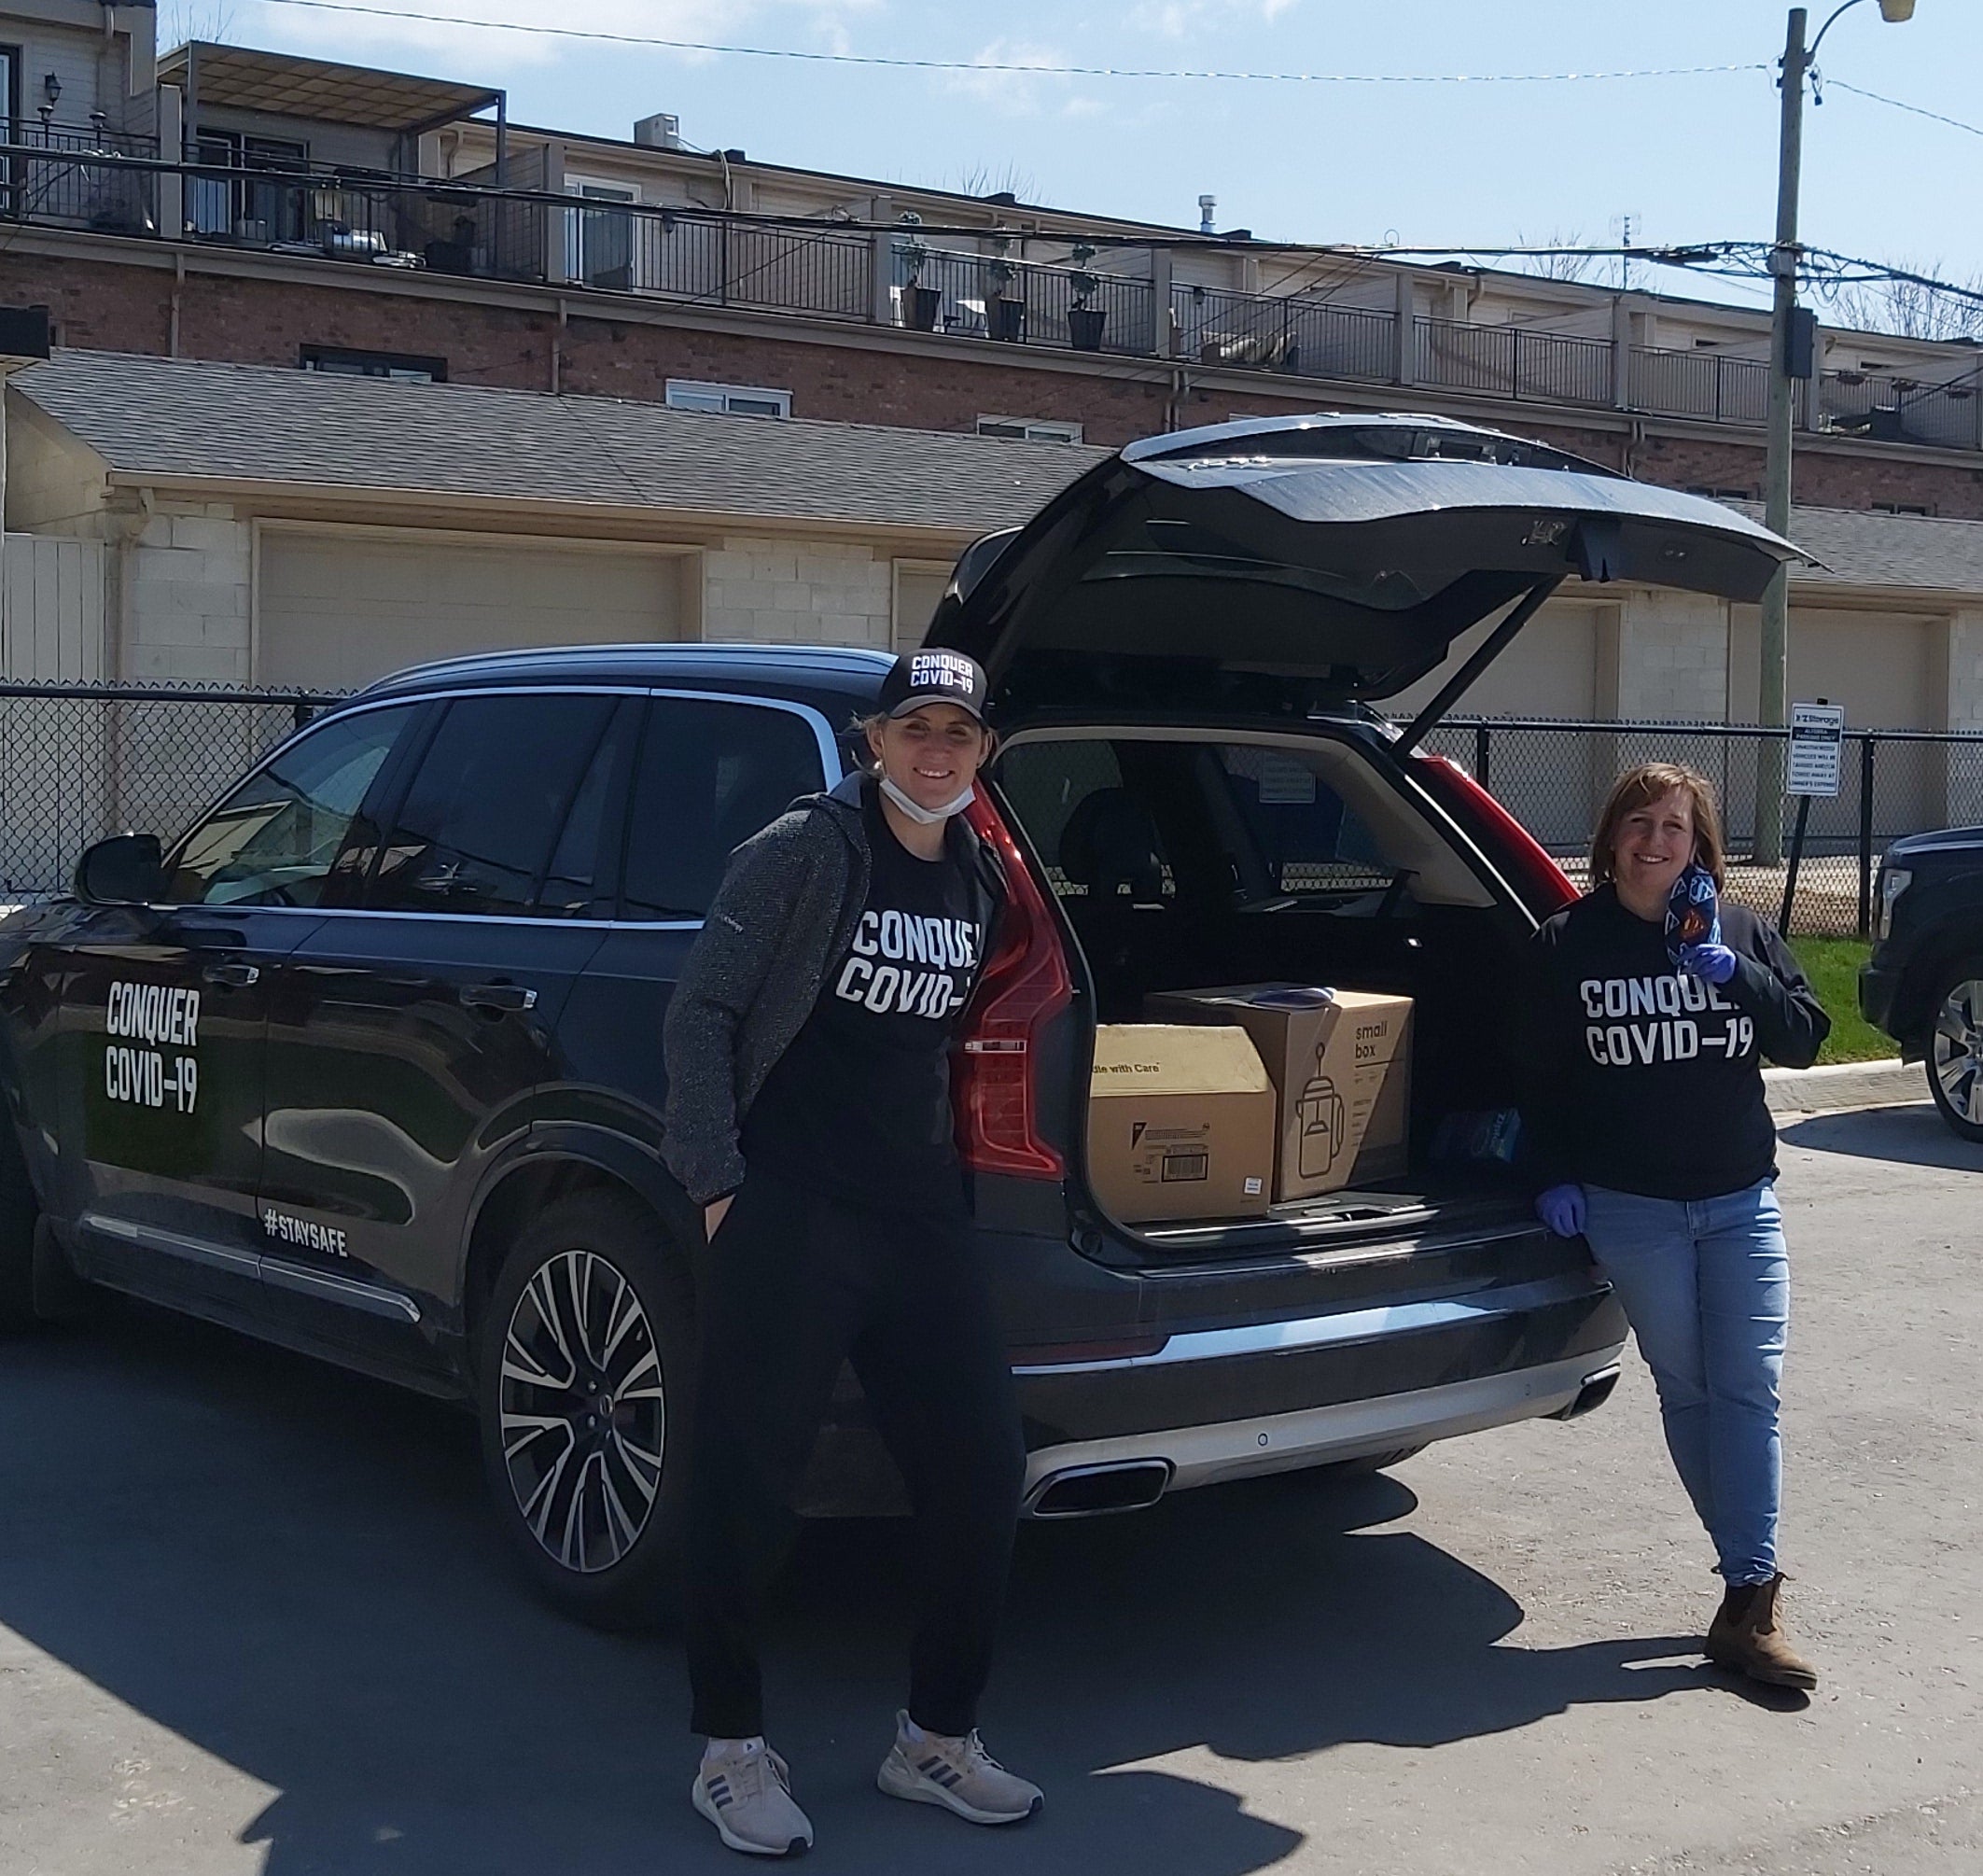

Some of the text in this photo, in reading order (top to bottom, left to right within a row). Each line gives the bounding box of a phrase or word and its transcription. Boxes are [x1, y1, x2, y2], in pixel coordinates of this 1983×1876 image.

[910, 670, 973, 694] COVID-19
[912, 654, 973, 678] CONQUER
[835, 958, 971, 1019] COVID-
[1581, 974, 1741, 1018] CONQUE
[106, 981, 200, 1046] CONQUER
[1356, 1020, 1388, 1040] small
[1355, 1043, 1376, 1058] box
[1585, 1015, 1754, 1066] COVID-19
[105, 1046, 198, 1114] COVID-19
[1110, 1064, 1133, 1073] with
[264, 1208, 348, 1258] #STAYSAFE
